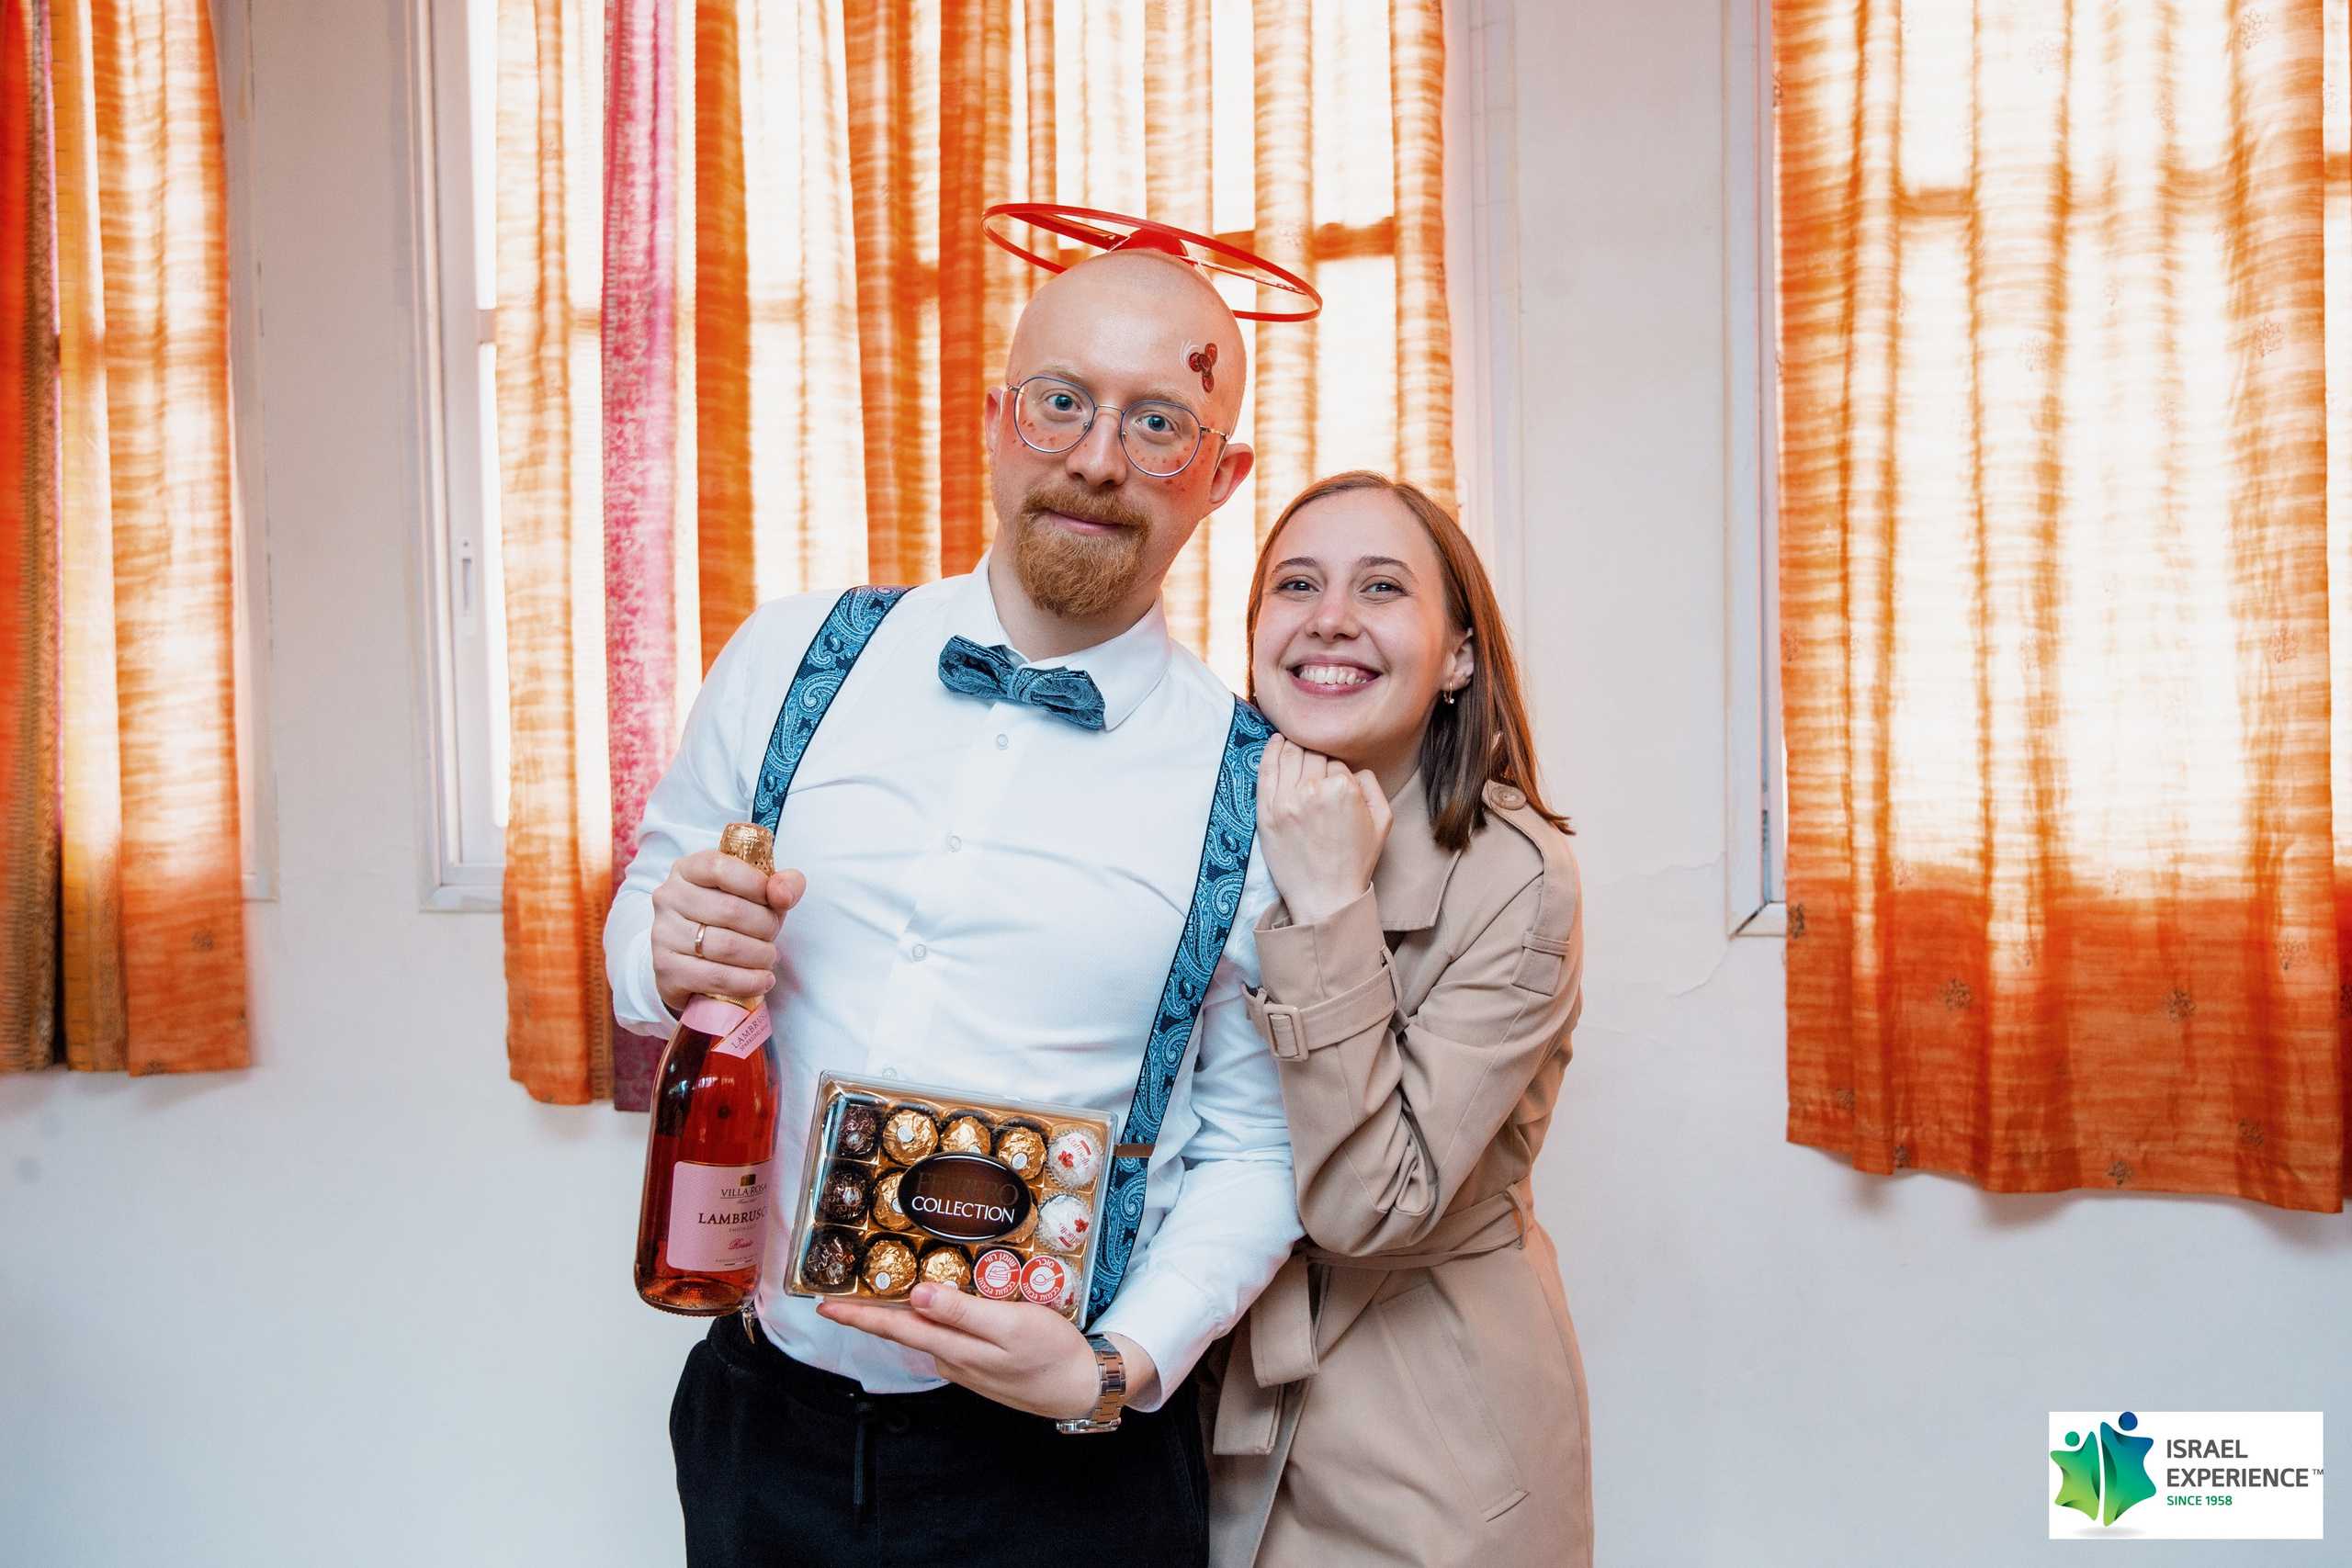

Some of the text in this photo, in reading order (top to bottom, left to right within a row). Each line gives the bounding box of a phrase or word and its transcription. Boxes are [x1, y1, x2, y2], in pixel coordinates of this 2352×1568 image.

[731, 1010, 768, 1049] LAMBRUSC
[740, 1030, 762, 1051] SPARKLING
[1067, 1136, 1090, 1169] Raffaello
[721, 1183, 767, 1197] VILLA ROSA
[911, 1196, 1015, 1224] COLLECTION
[1058, 1222, 1080, 1245] affaello
[984, 1253, 1017, 1268] שומן רווי
[1035, 1258, 1055, 1268] סוכר
[978, 1277, 1016, 1296] בכמות גבוהה
[1023, 1282, 1038, 1300] גבוהה
[1039, 1286, 1060, 1301] בכמות
